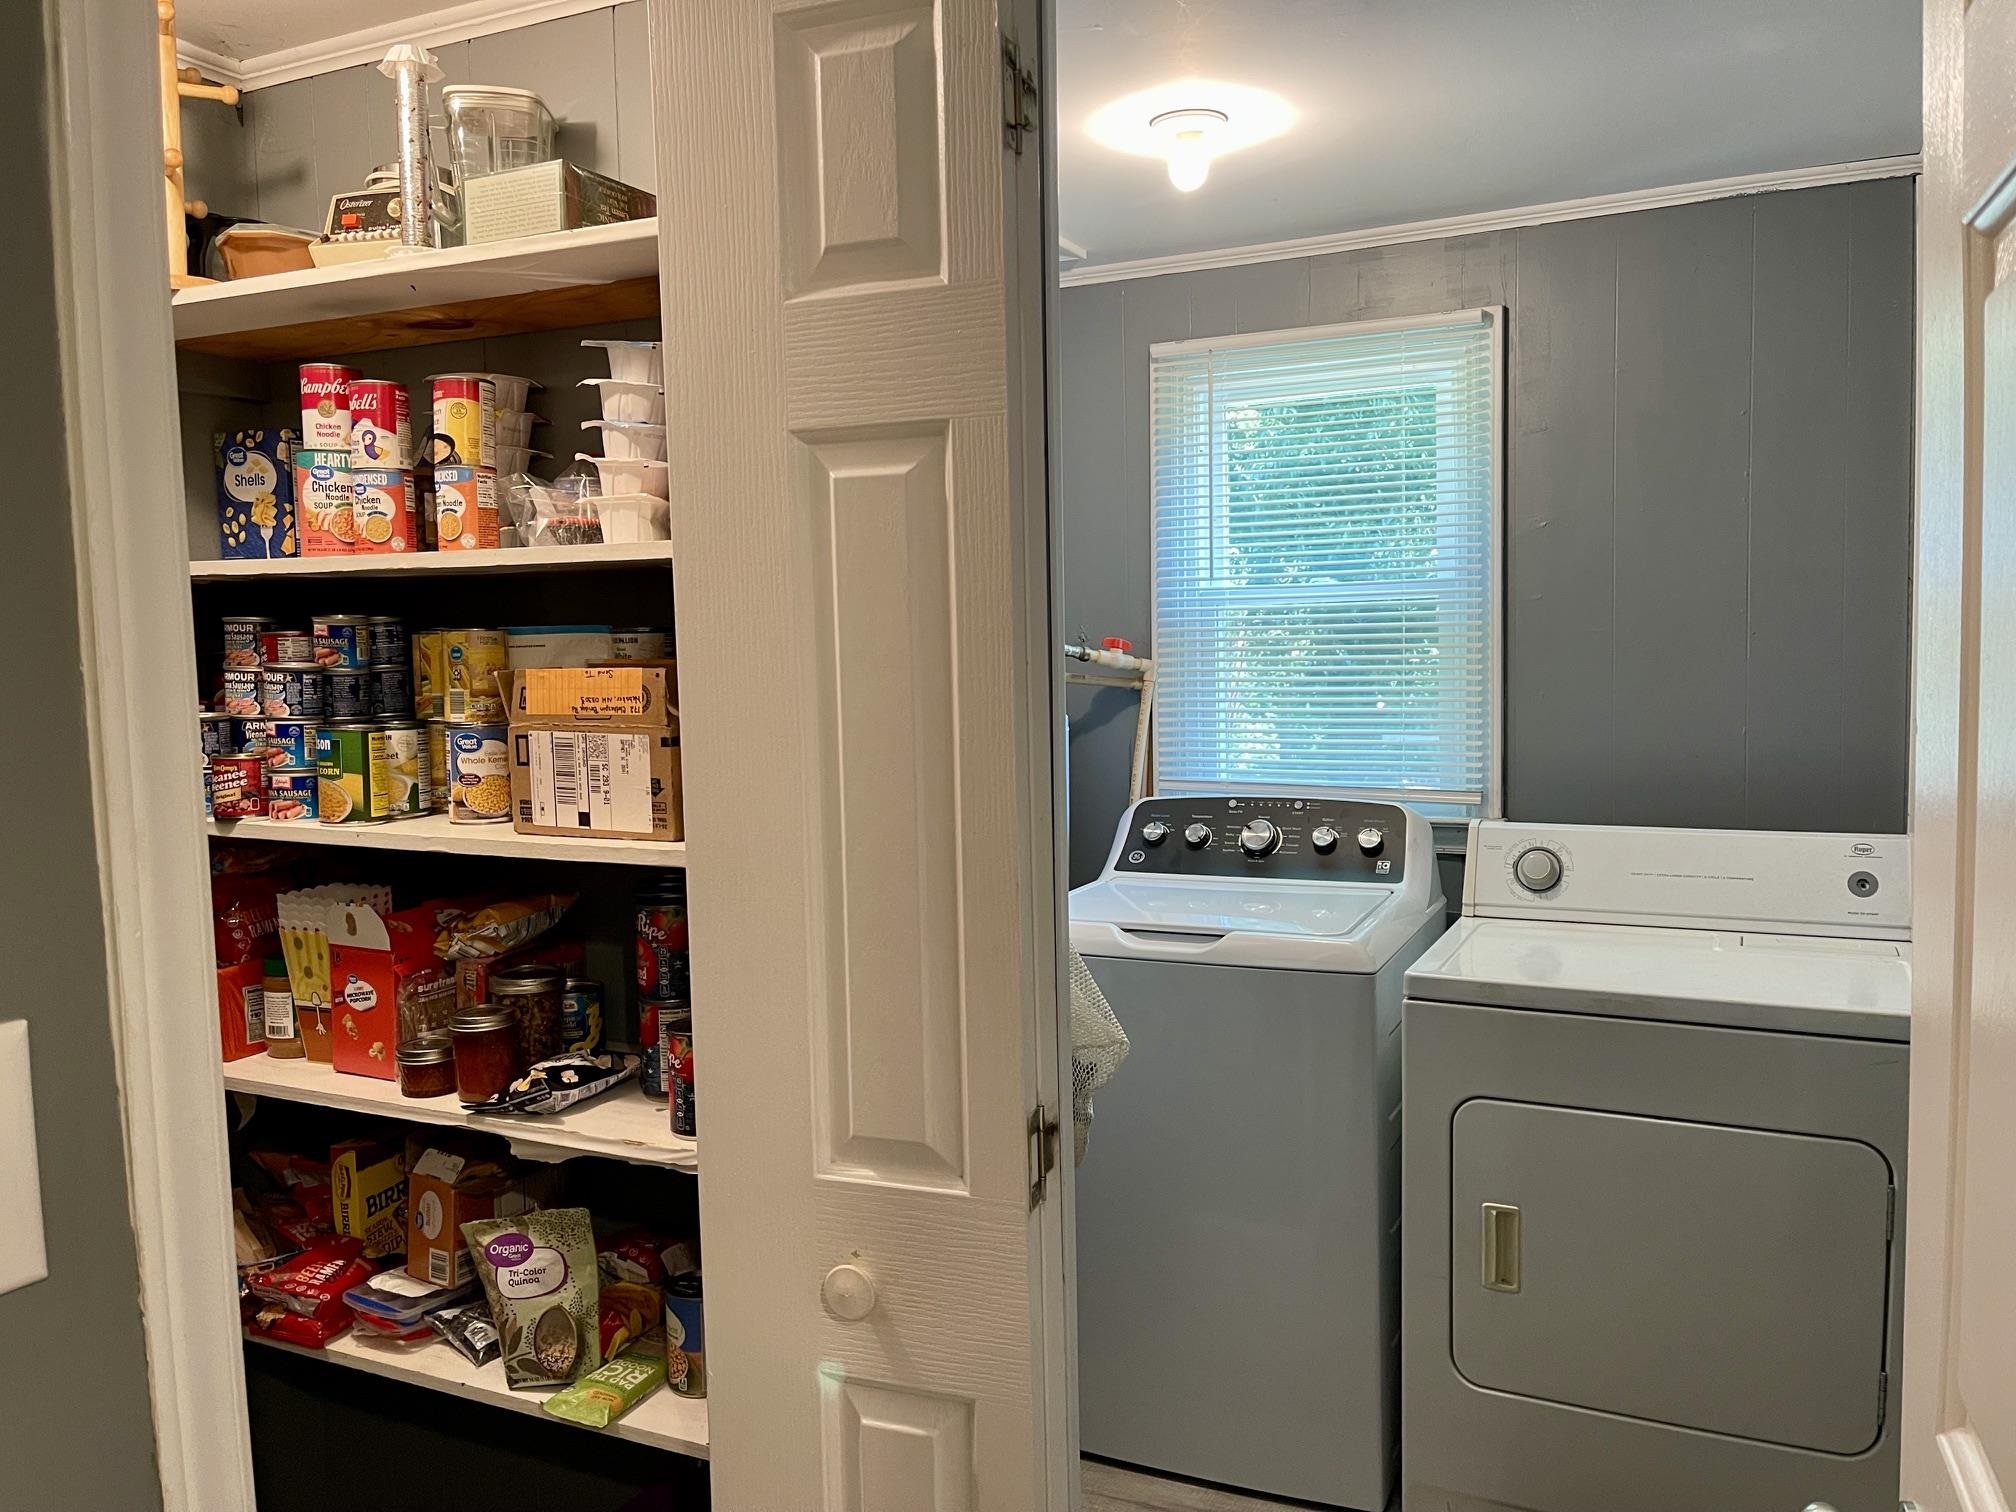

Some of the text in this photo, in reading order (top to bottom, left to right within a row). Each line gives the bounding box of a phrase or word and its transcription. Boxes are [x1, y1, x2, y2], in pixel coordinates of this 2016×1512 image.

[340, 199, 373, 210] Osterizer
[301, 378, 349, 397] Campbe
[350, 393, 377, 410] bell's
[234, 473, 266, 487] Shells
[312, 480, 352, 493] Chicken
[326, 492, 350, 502] Noodle
[355, 495, 381, 505] Chicken
[442, 499, 463, 507] Noodle
[314, 501, 334, 509] SOUP
[597, 670, 614, 678] Send
[316, 739, 331, 750] son
[456, 738, 478, 746] Great
[602, 763, 608, 771] SC
[212, 769, 247, 783] eanee
[212, 777, 248, 792] eenee
[216, 792, 236, 800] Original
[279, 789, 311, 797] SAUSAGE
[637, 912, 667, 940] Ripe
[465, 970, 477, 991] RITZ
[347, 990, 374, 998] MICROWAVE
[669, 1053, 682, 1069] pe
[366, 1181, 406, 1218] BIRR
[489, 1241, 529, 1257] Organic
[308, 1259, 346, 1286] RAMEN
[508, 1267, 546, 1278] Tri-Color
[508, 1277, 540, 1287] Quinoa
[602, 1364, 649, 1384] RIC
[609, 1376, 635, 1390] PAD
